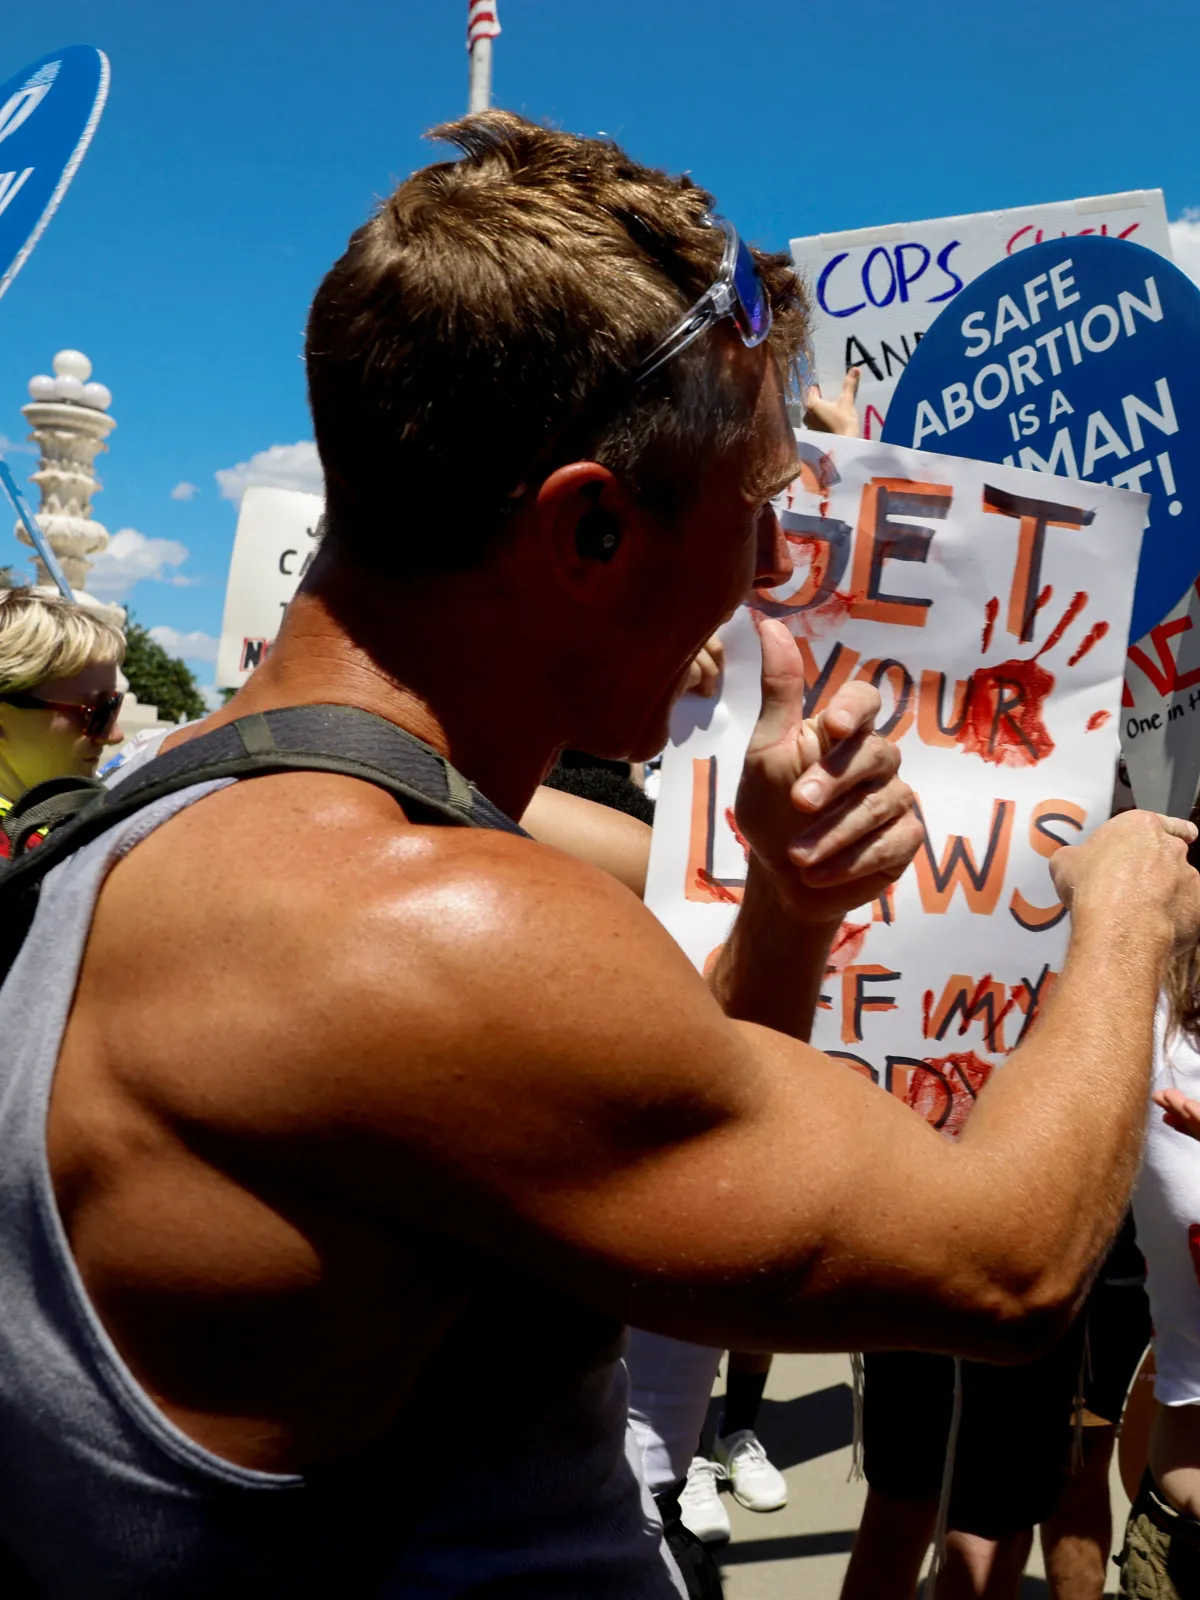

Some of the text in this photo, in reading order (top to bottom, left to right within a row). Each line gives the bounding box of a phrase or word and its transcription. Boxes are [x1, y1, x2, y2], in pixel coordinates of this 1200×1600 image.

[817, 239, 964, 318] COPS
[961, 258, 1081, 358] SAFE
[845, 335, 925, 381] AN
[912, 275, 1164, 449] ABORTION
[1002, 376, 1179, 480] MAN
[1009, 389, 1075, 442] IS A
[748, 441, 1097, 646] GET
[797, 636, 1041, 760] YOUR
[1127, 713, 1162, 739] One
[1166, 703, 1184, 721] in
[685, 755, 1088, 933] LWS
[926, 963, 1060, 1054] MY
